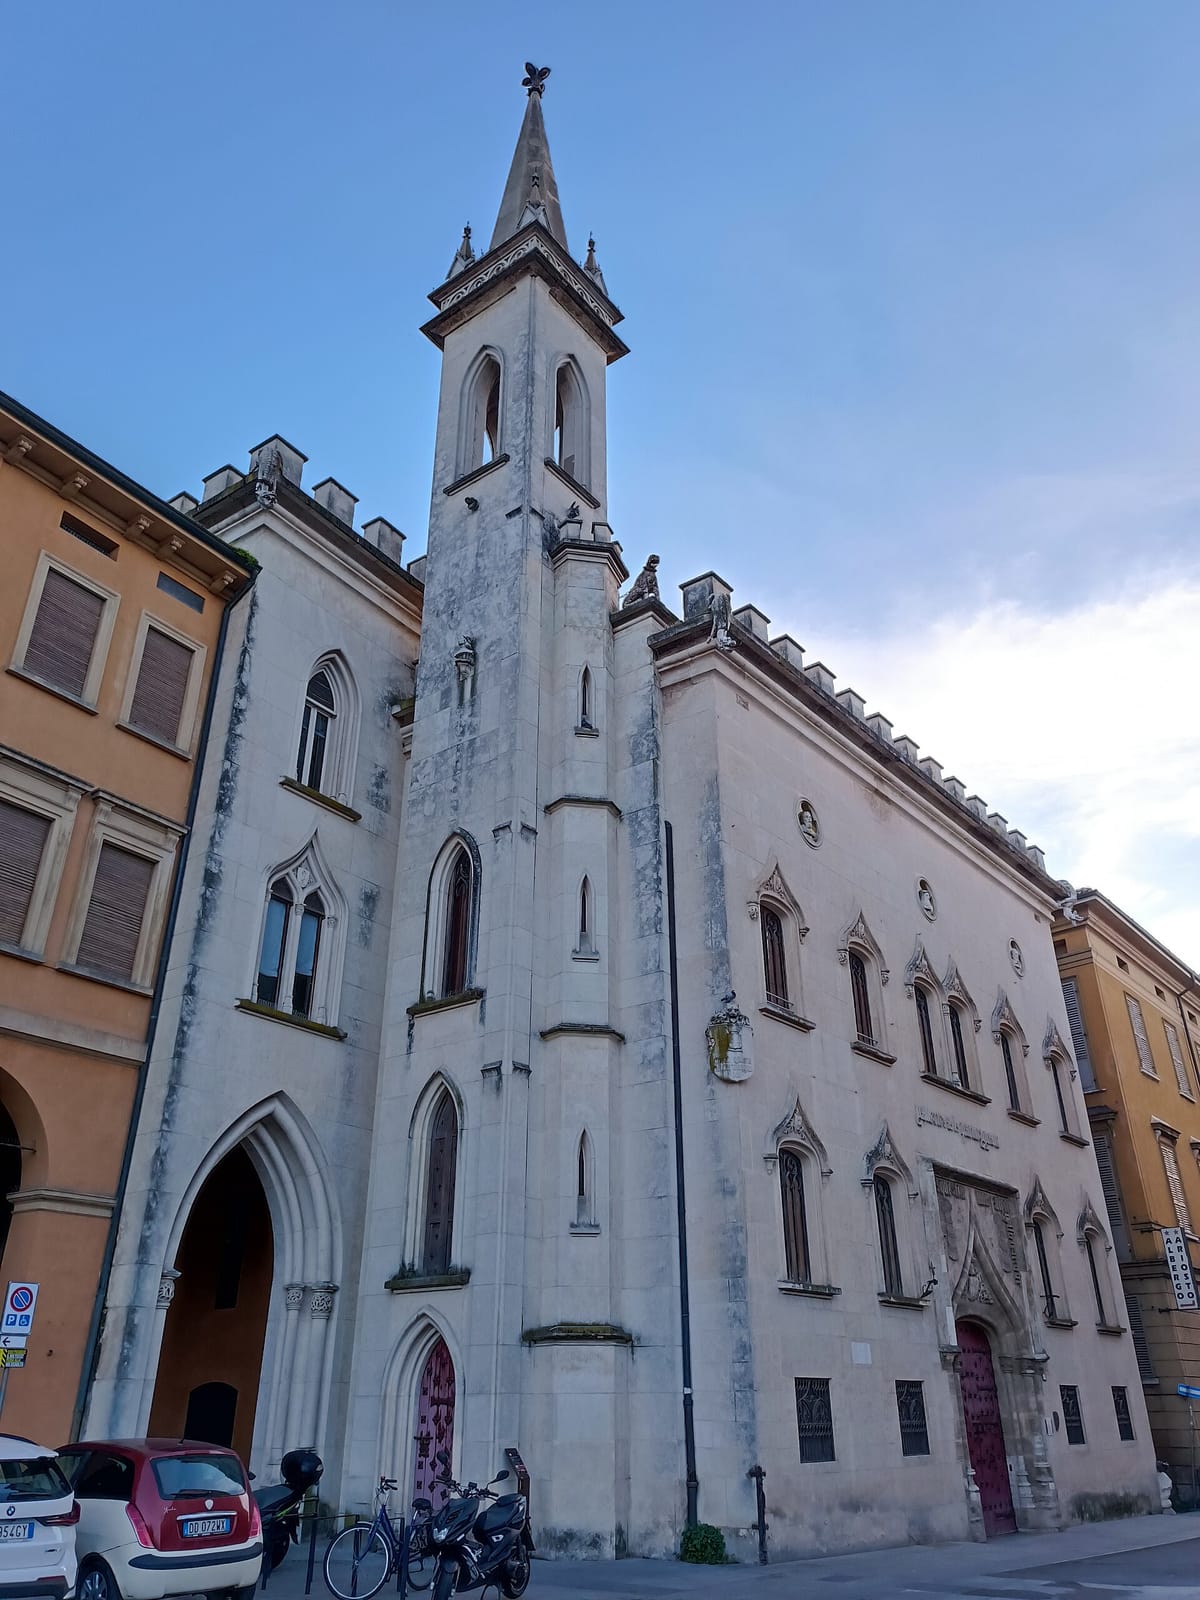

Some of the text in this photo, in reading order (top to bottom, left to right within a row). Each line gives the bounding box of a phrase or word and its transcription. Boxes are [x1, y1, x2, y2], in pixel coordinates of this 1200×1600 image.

[1166, 1237, 1184, 1299] ALBERGO
[1175, 1236, 1194, 1299] ARIOSTO
[8, 1315, 16, 1325] P
